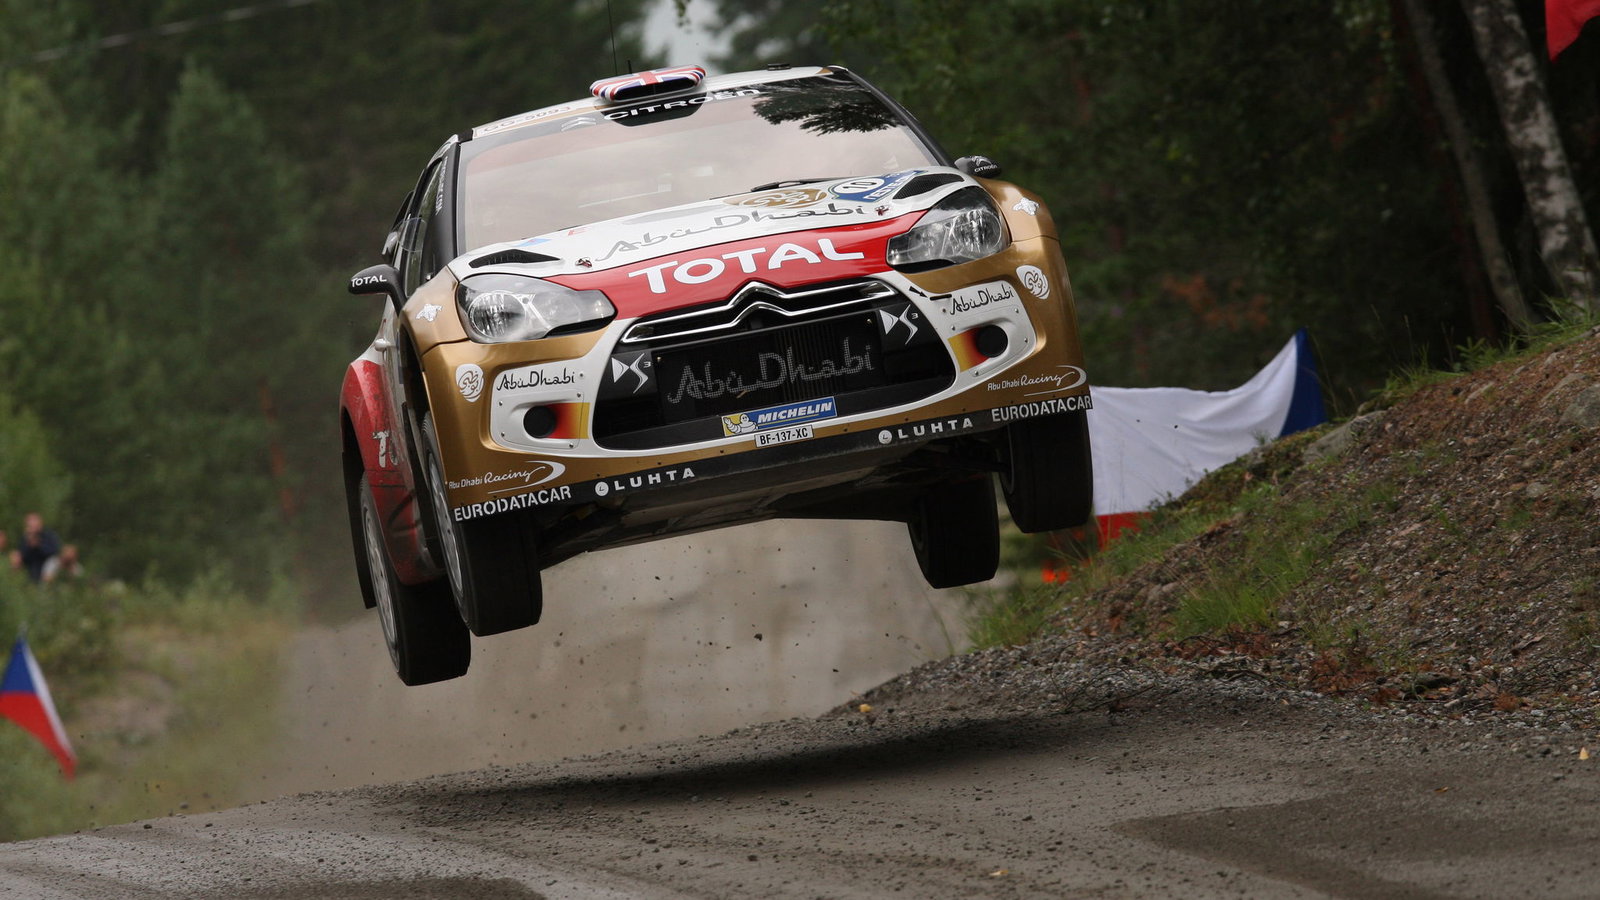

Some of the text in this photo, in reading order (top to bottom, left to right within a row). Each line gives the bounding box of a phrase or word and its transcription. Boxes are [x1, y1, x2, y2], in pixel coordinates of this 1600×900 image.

[627, 238, 865, 294] TOTAL
[351, 274, 388, 288] TOTAL
[987, 371, 1075, 391] Abu Dhabi Racing
[757, 401, 833, 424] MICHELIN
[991, 395, 1093, 422] EURODATACAR
[759, 427, 808, 445] BF-137-XC
[897, 417, 974, 440] LUHTA
[449, 466, 546, 490] Abu Dhabi Racing
[614, 467, 695, 492] LUHTA
[454, 485, 572, 522] EURODATACAR
